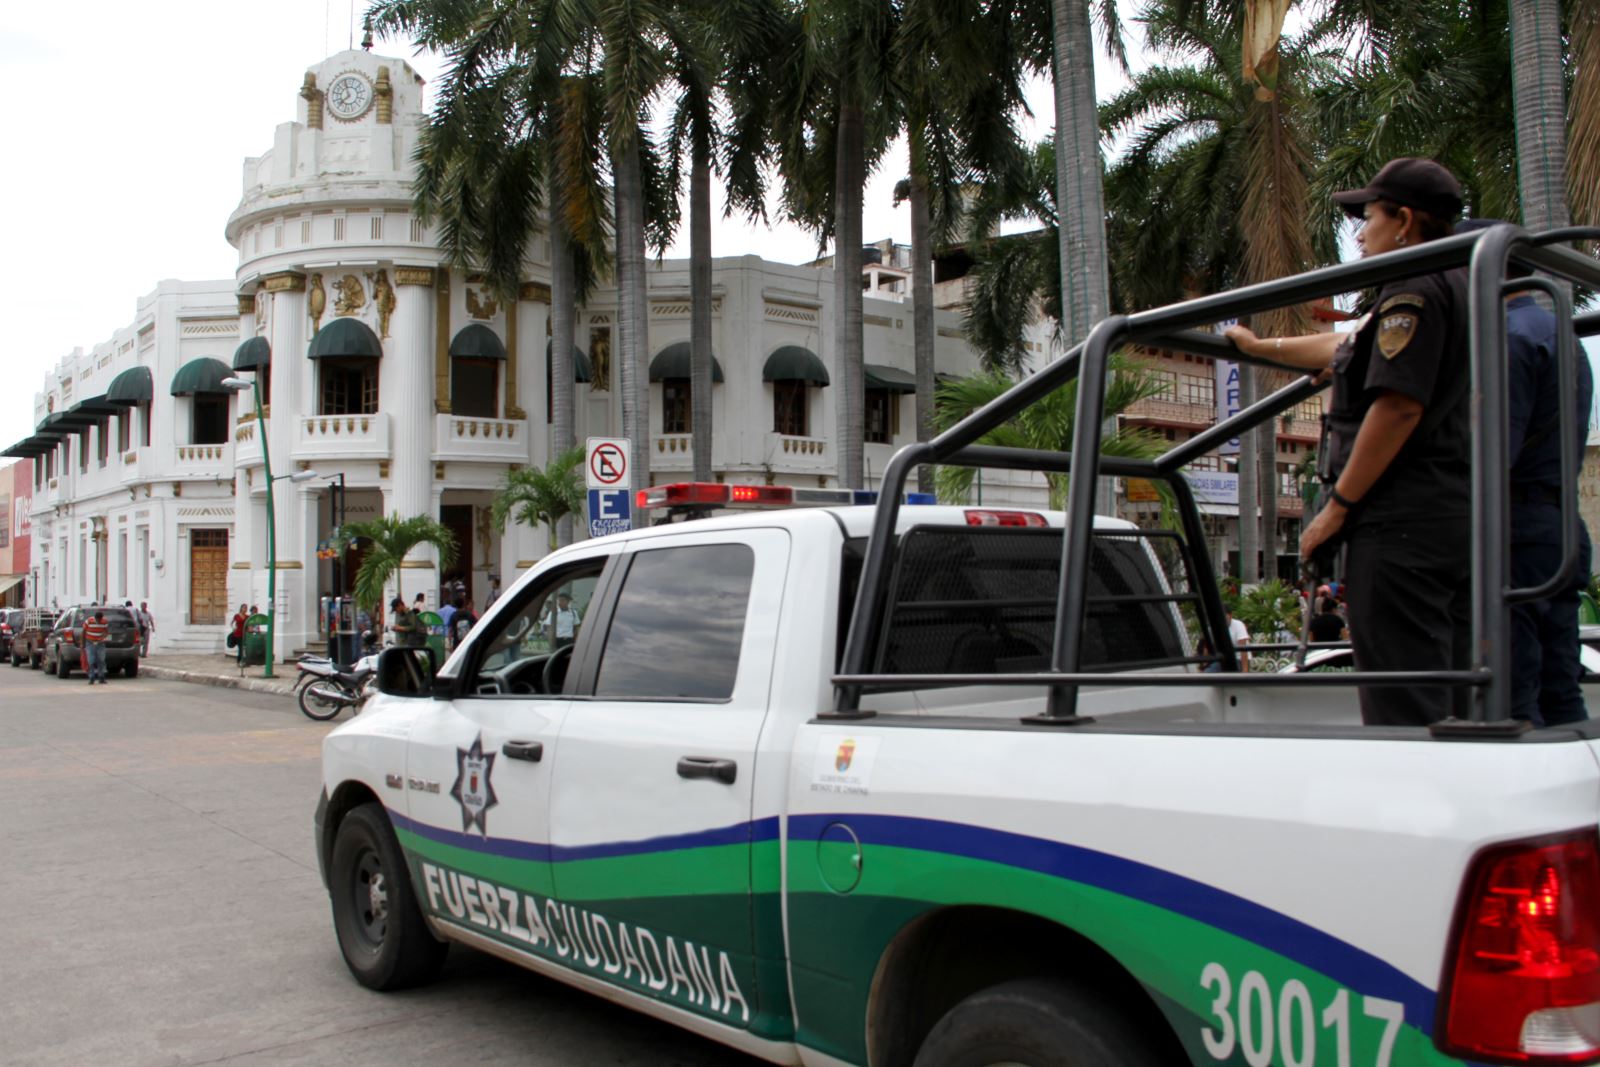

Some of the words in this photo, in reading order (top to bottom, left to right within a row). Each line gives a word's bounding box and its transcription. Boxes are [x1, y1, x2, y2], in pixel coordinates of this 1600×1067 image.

[600, 451, 617, 476] E
[599, 490, 620, 519] E
[423, 863, 549, 948] FUERZA
[545, 899, 749, 1022] CIUDADANA
[1200, 962, 1405, 1067] 30017
